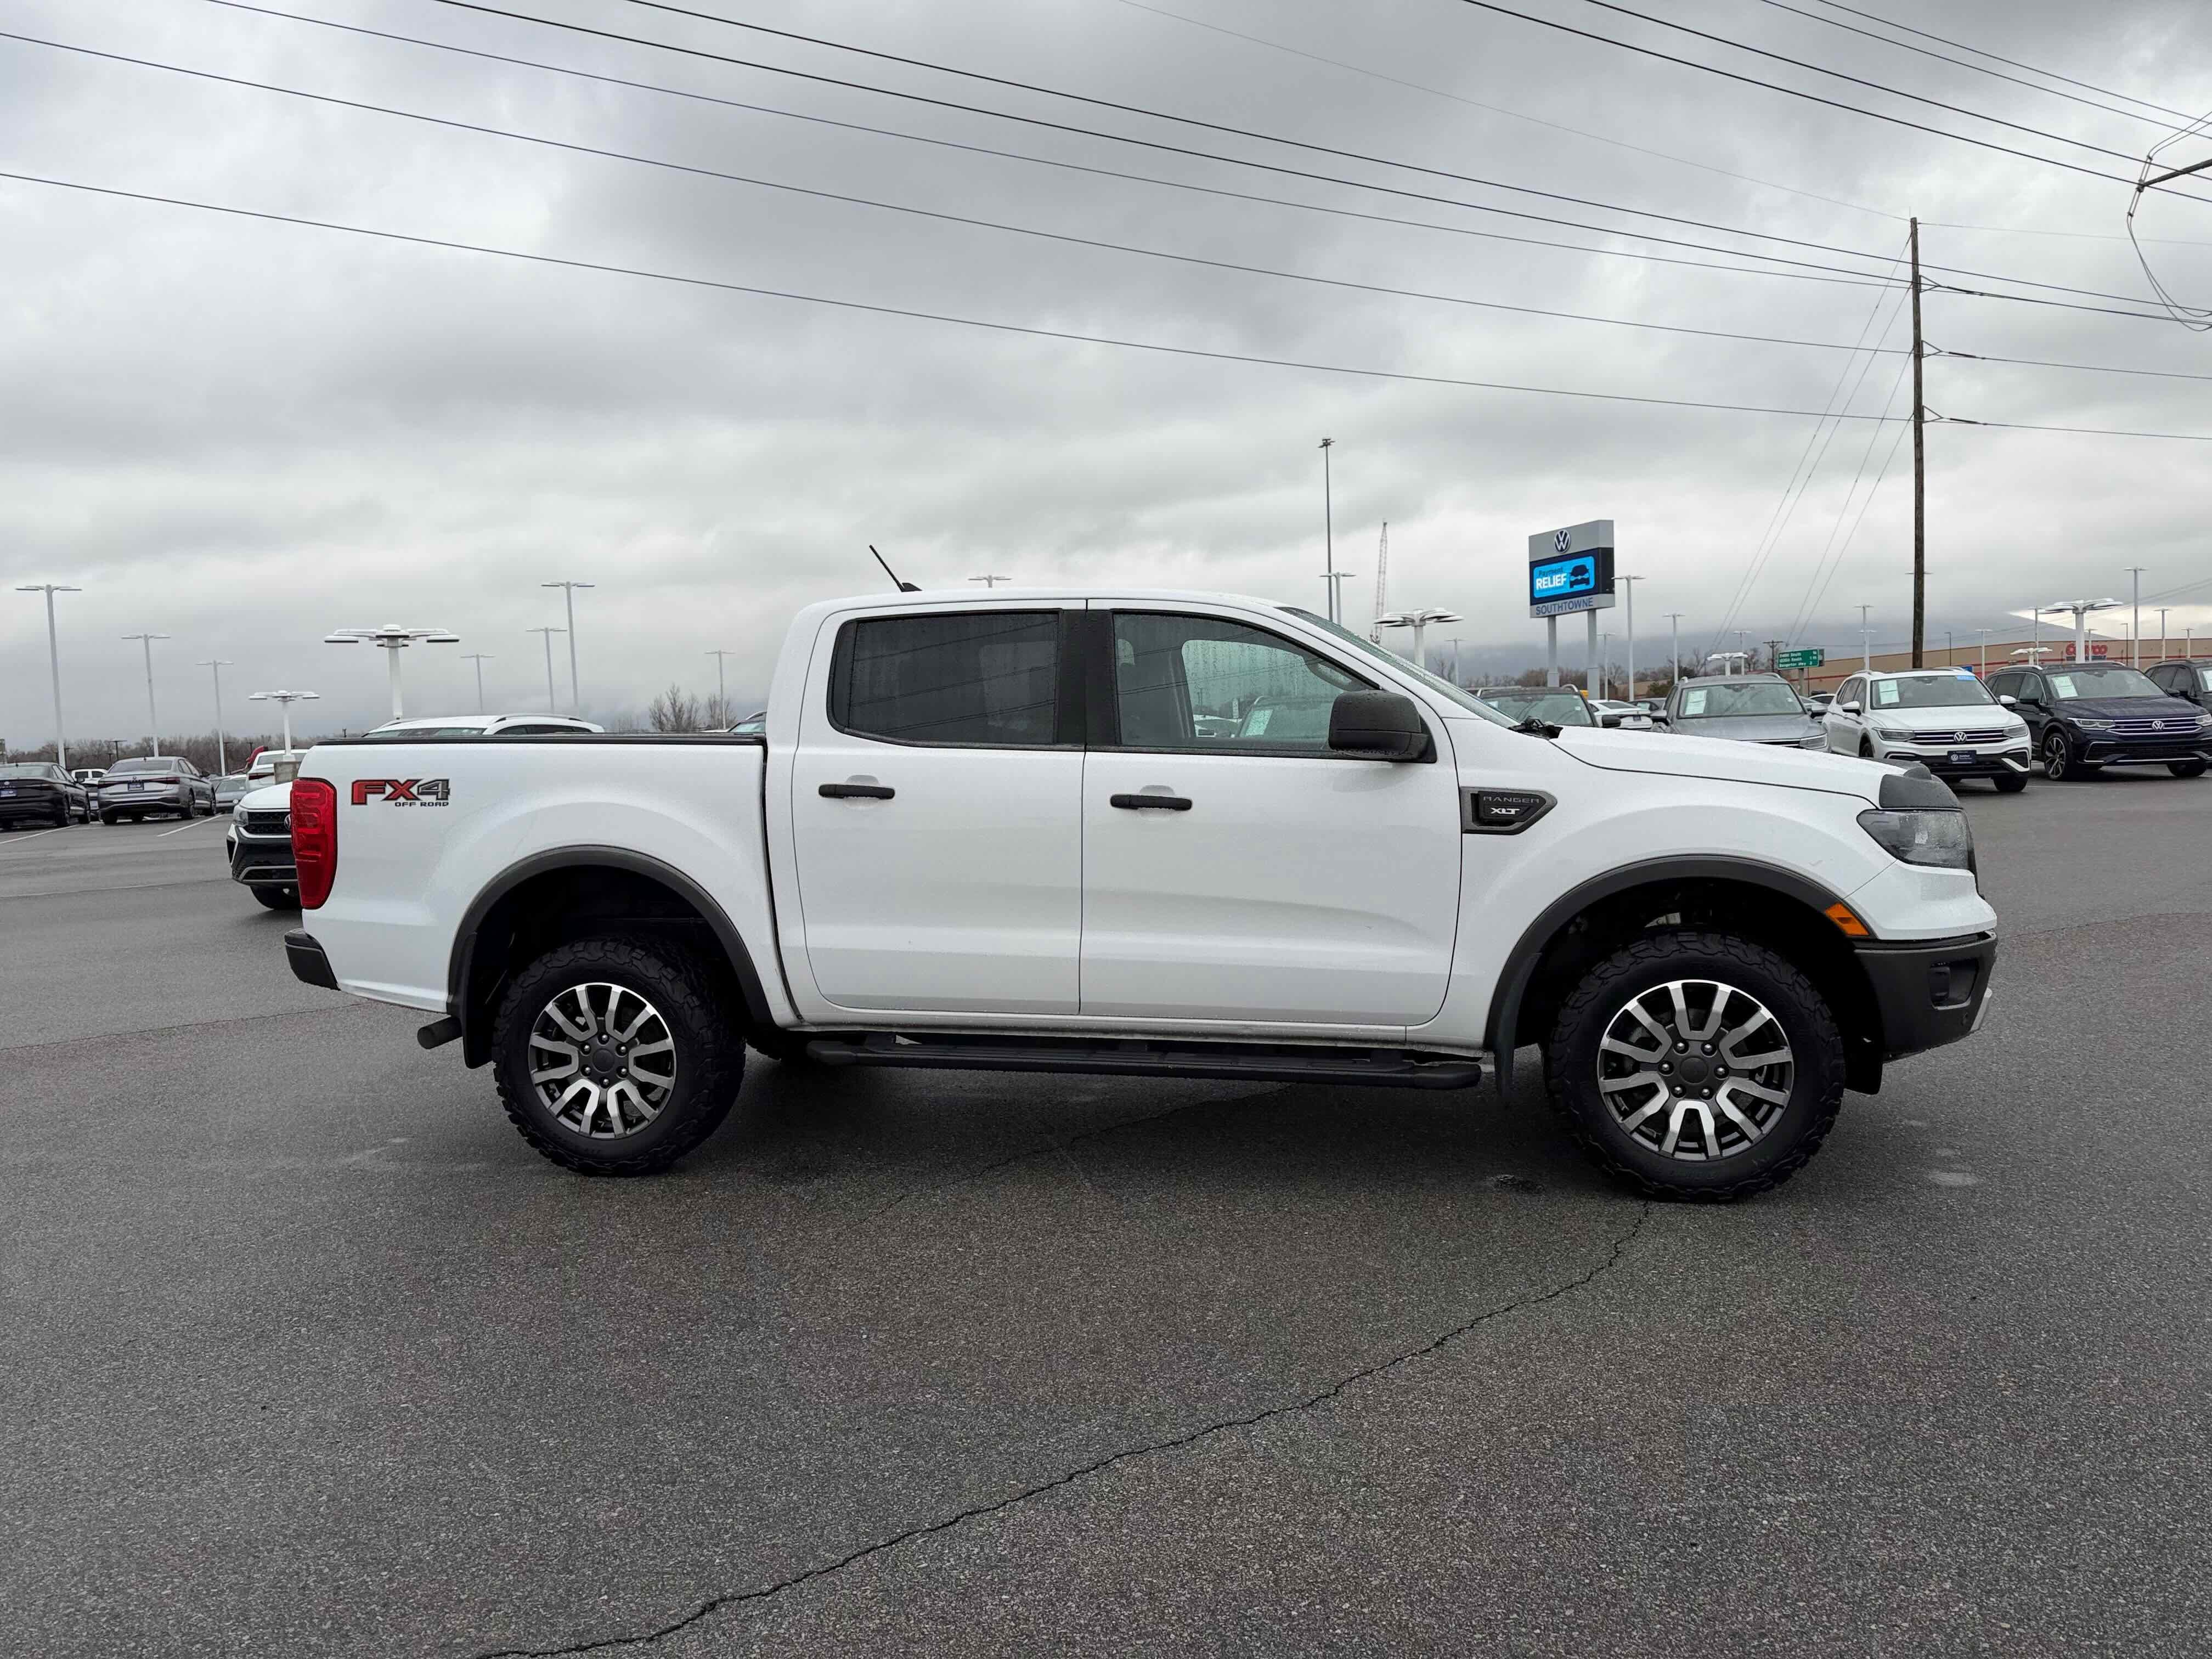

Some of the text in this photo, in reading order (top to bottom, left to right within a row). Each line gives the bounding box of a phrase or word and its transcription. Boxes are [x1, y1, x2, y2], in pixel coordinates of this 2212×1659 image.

[1536, 573, 1567, 590] RELIEF
[1536, 597, 1594, 615] SOUTHTOWNE
[351, 779, 450, 805] FX4
